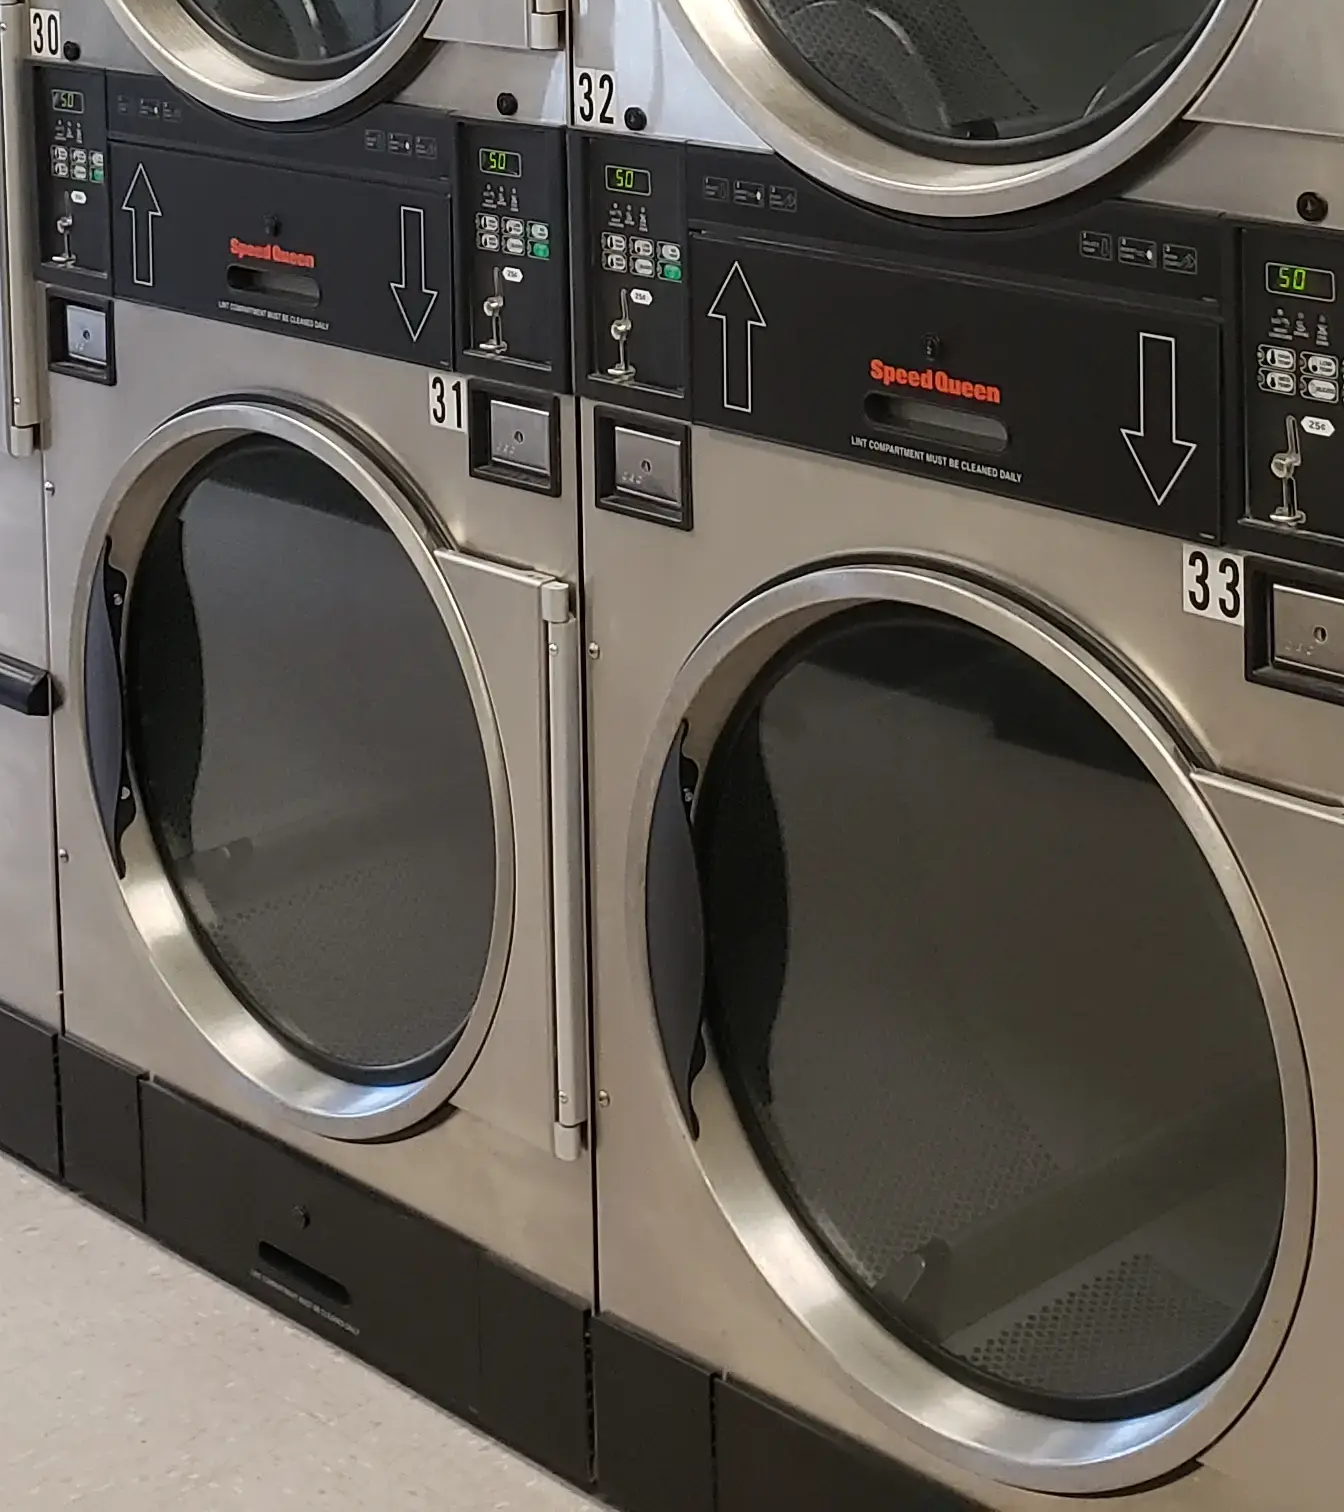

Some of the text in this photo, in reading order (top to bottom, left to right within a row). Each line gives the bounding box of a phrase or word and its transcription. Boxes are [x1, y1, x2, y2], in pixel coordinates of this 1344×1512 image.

[33, 12, 58, 55] 30
[579, 72, 614, 124] 32
[489, 151, 506, 170] 50
[616, 169, 634, 188] 50
[1279, 267, 1306, 291] 50
[432, 376, 462, 429] 31
[870, 359, 1001, 404] Speed Queen
[1308, 418, 1326, 431] 25¢
[851, 435, 1023, 483] LINT COMPARTMENT MUST BE CLEANED DAILY
[1188, 551, 1241, 619] 33
